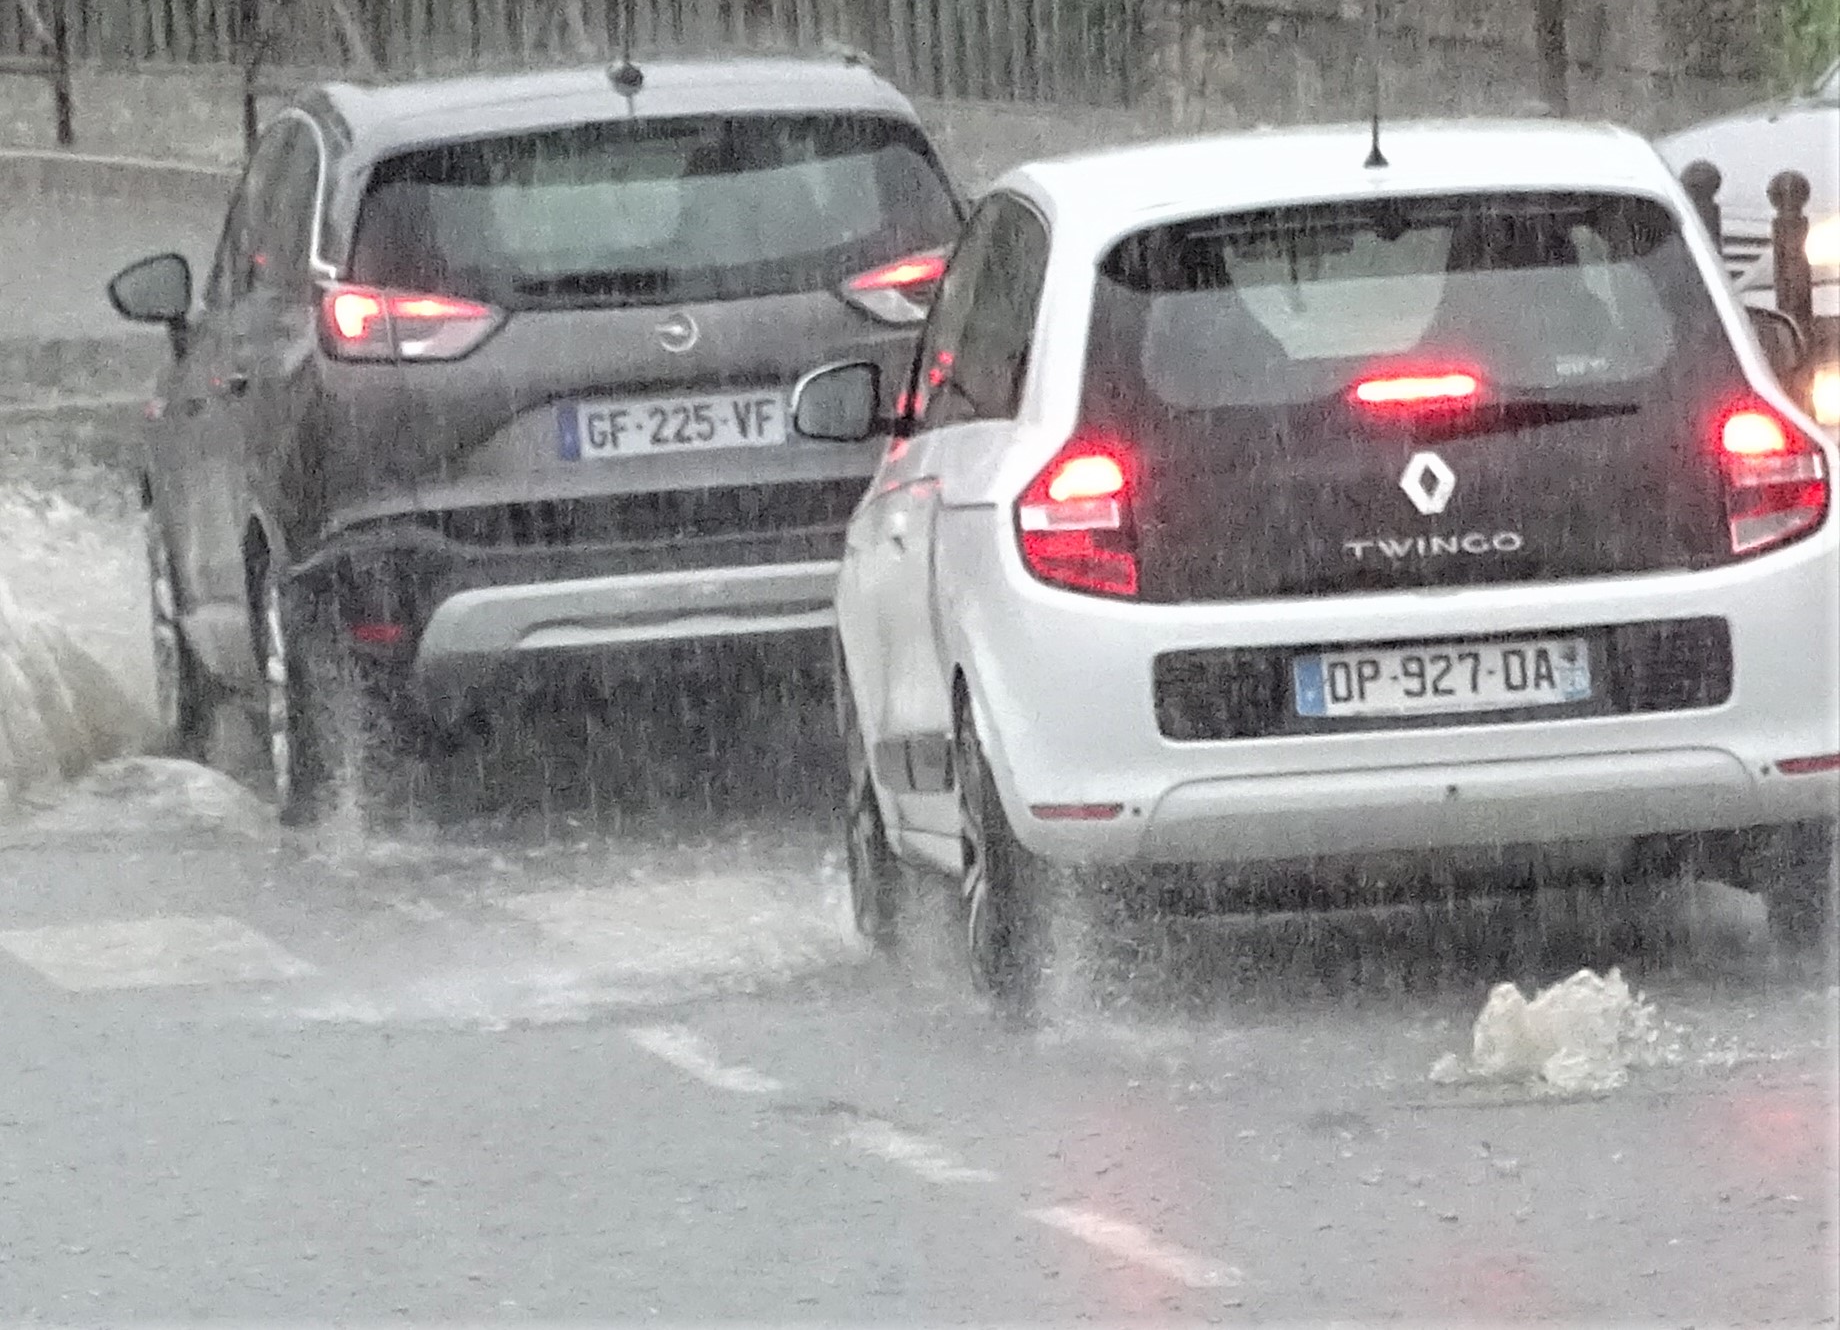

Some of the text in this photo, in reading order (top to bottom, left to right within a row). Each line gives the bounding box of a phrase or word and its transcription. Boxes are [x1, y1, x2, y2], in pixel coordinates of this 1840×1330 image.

[587, 398, 777, 450] GF-225-VF
[1343, 531, 1524, 561] TWINGO
[1326, 646, 1557, 704] DP-927-DA
